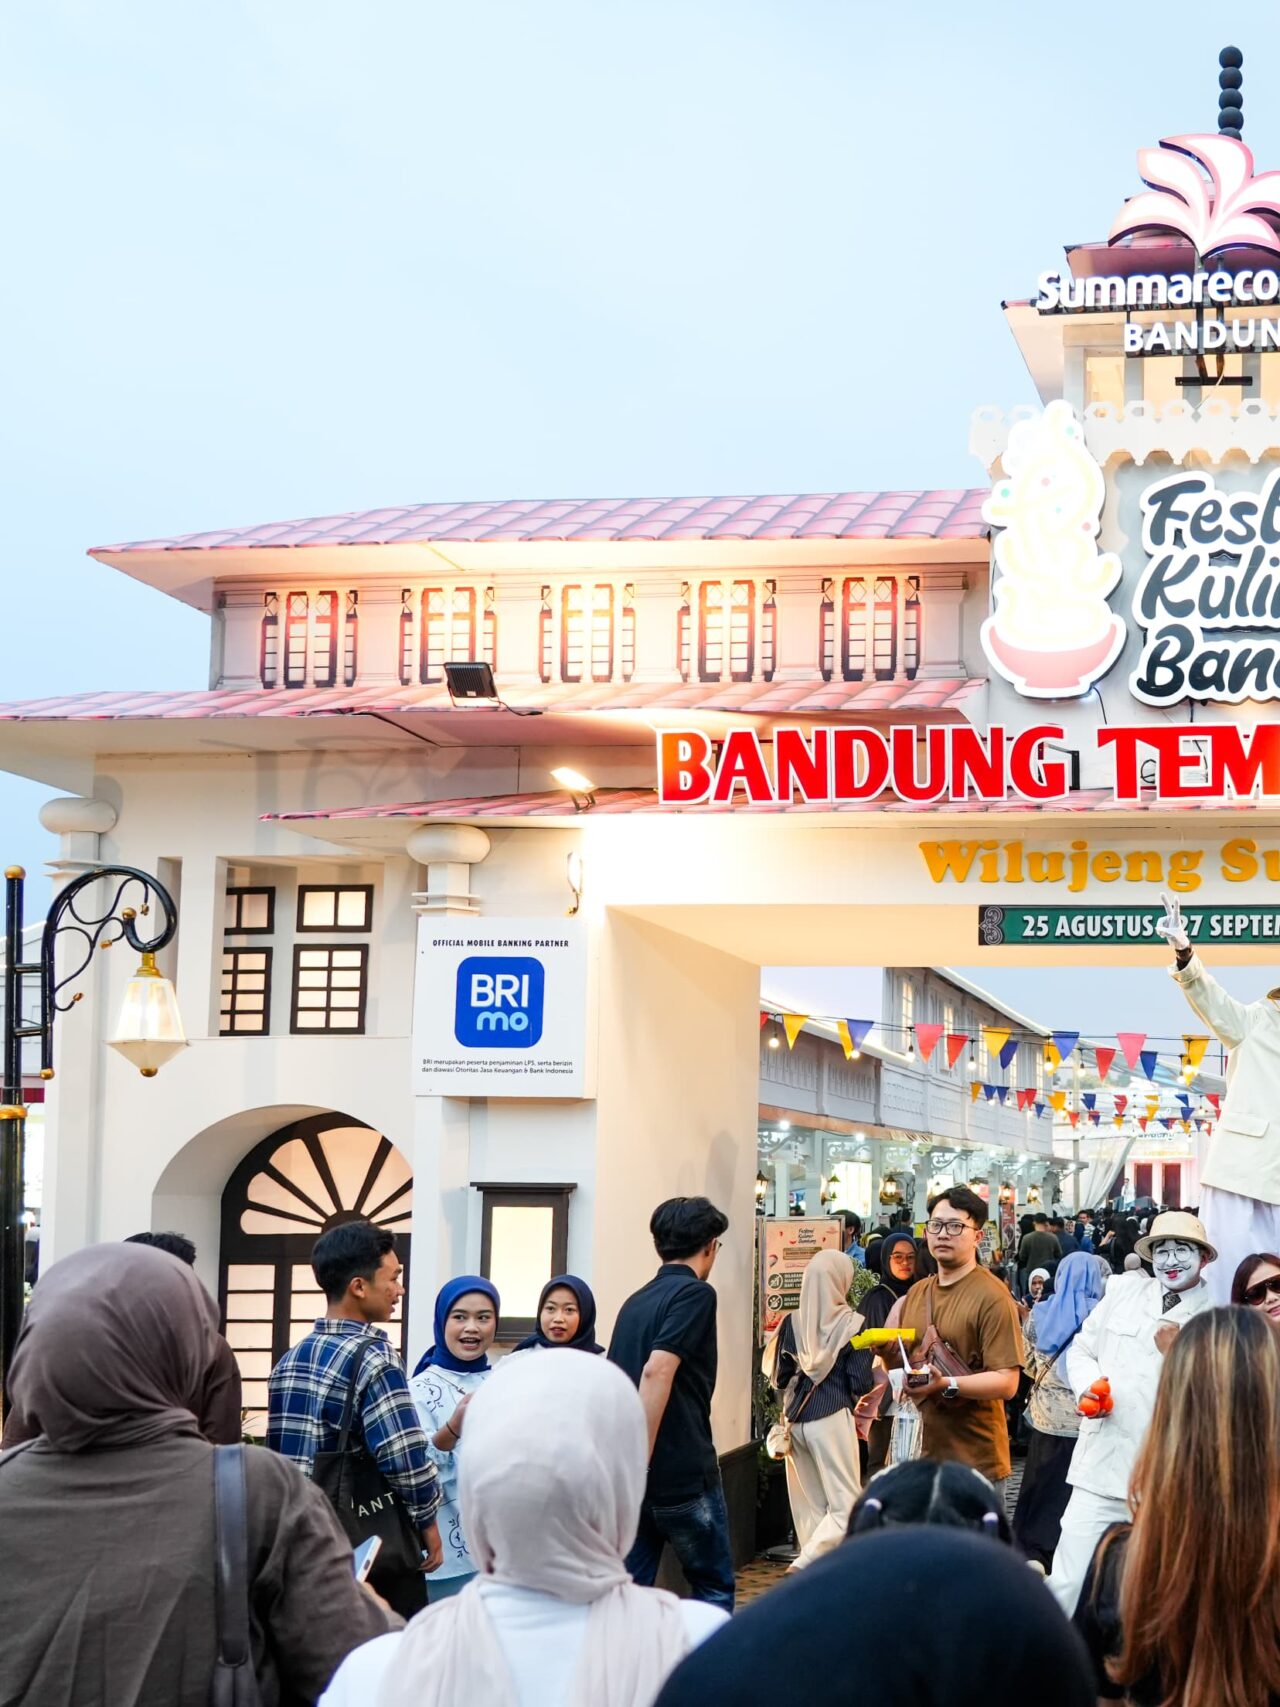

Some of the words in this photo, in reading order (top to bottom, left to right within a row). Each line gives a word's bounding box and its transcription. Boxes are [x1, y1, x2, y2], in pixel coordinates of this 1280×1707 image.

[657, 724, 1072, 804] BANDUNG
[919, 841, 1204, 892] Wilujeng
[1022, 915, 1049, 937] 25
[1055, 915, 1154, 937] AGUSTUS
[471, 974, 529, 1007] BRI
[476, 1011, 529, 1031] mo
